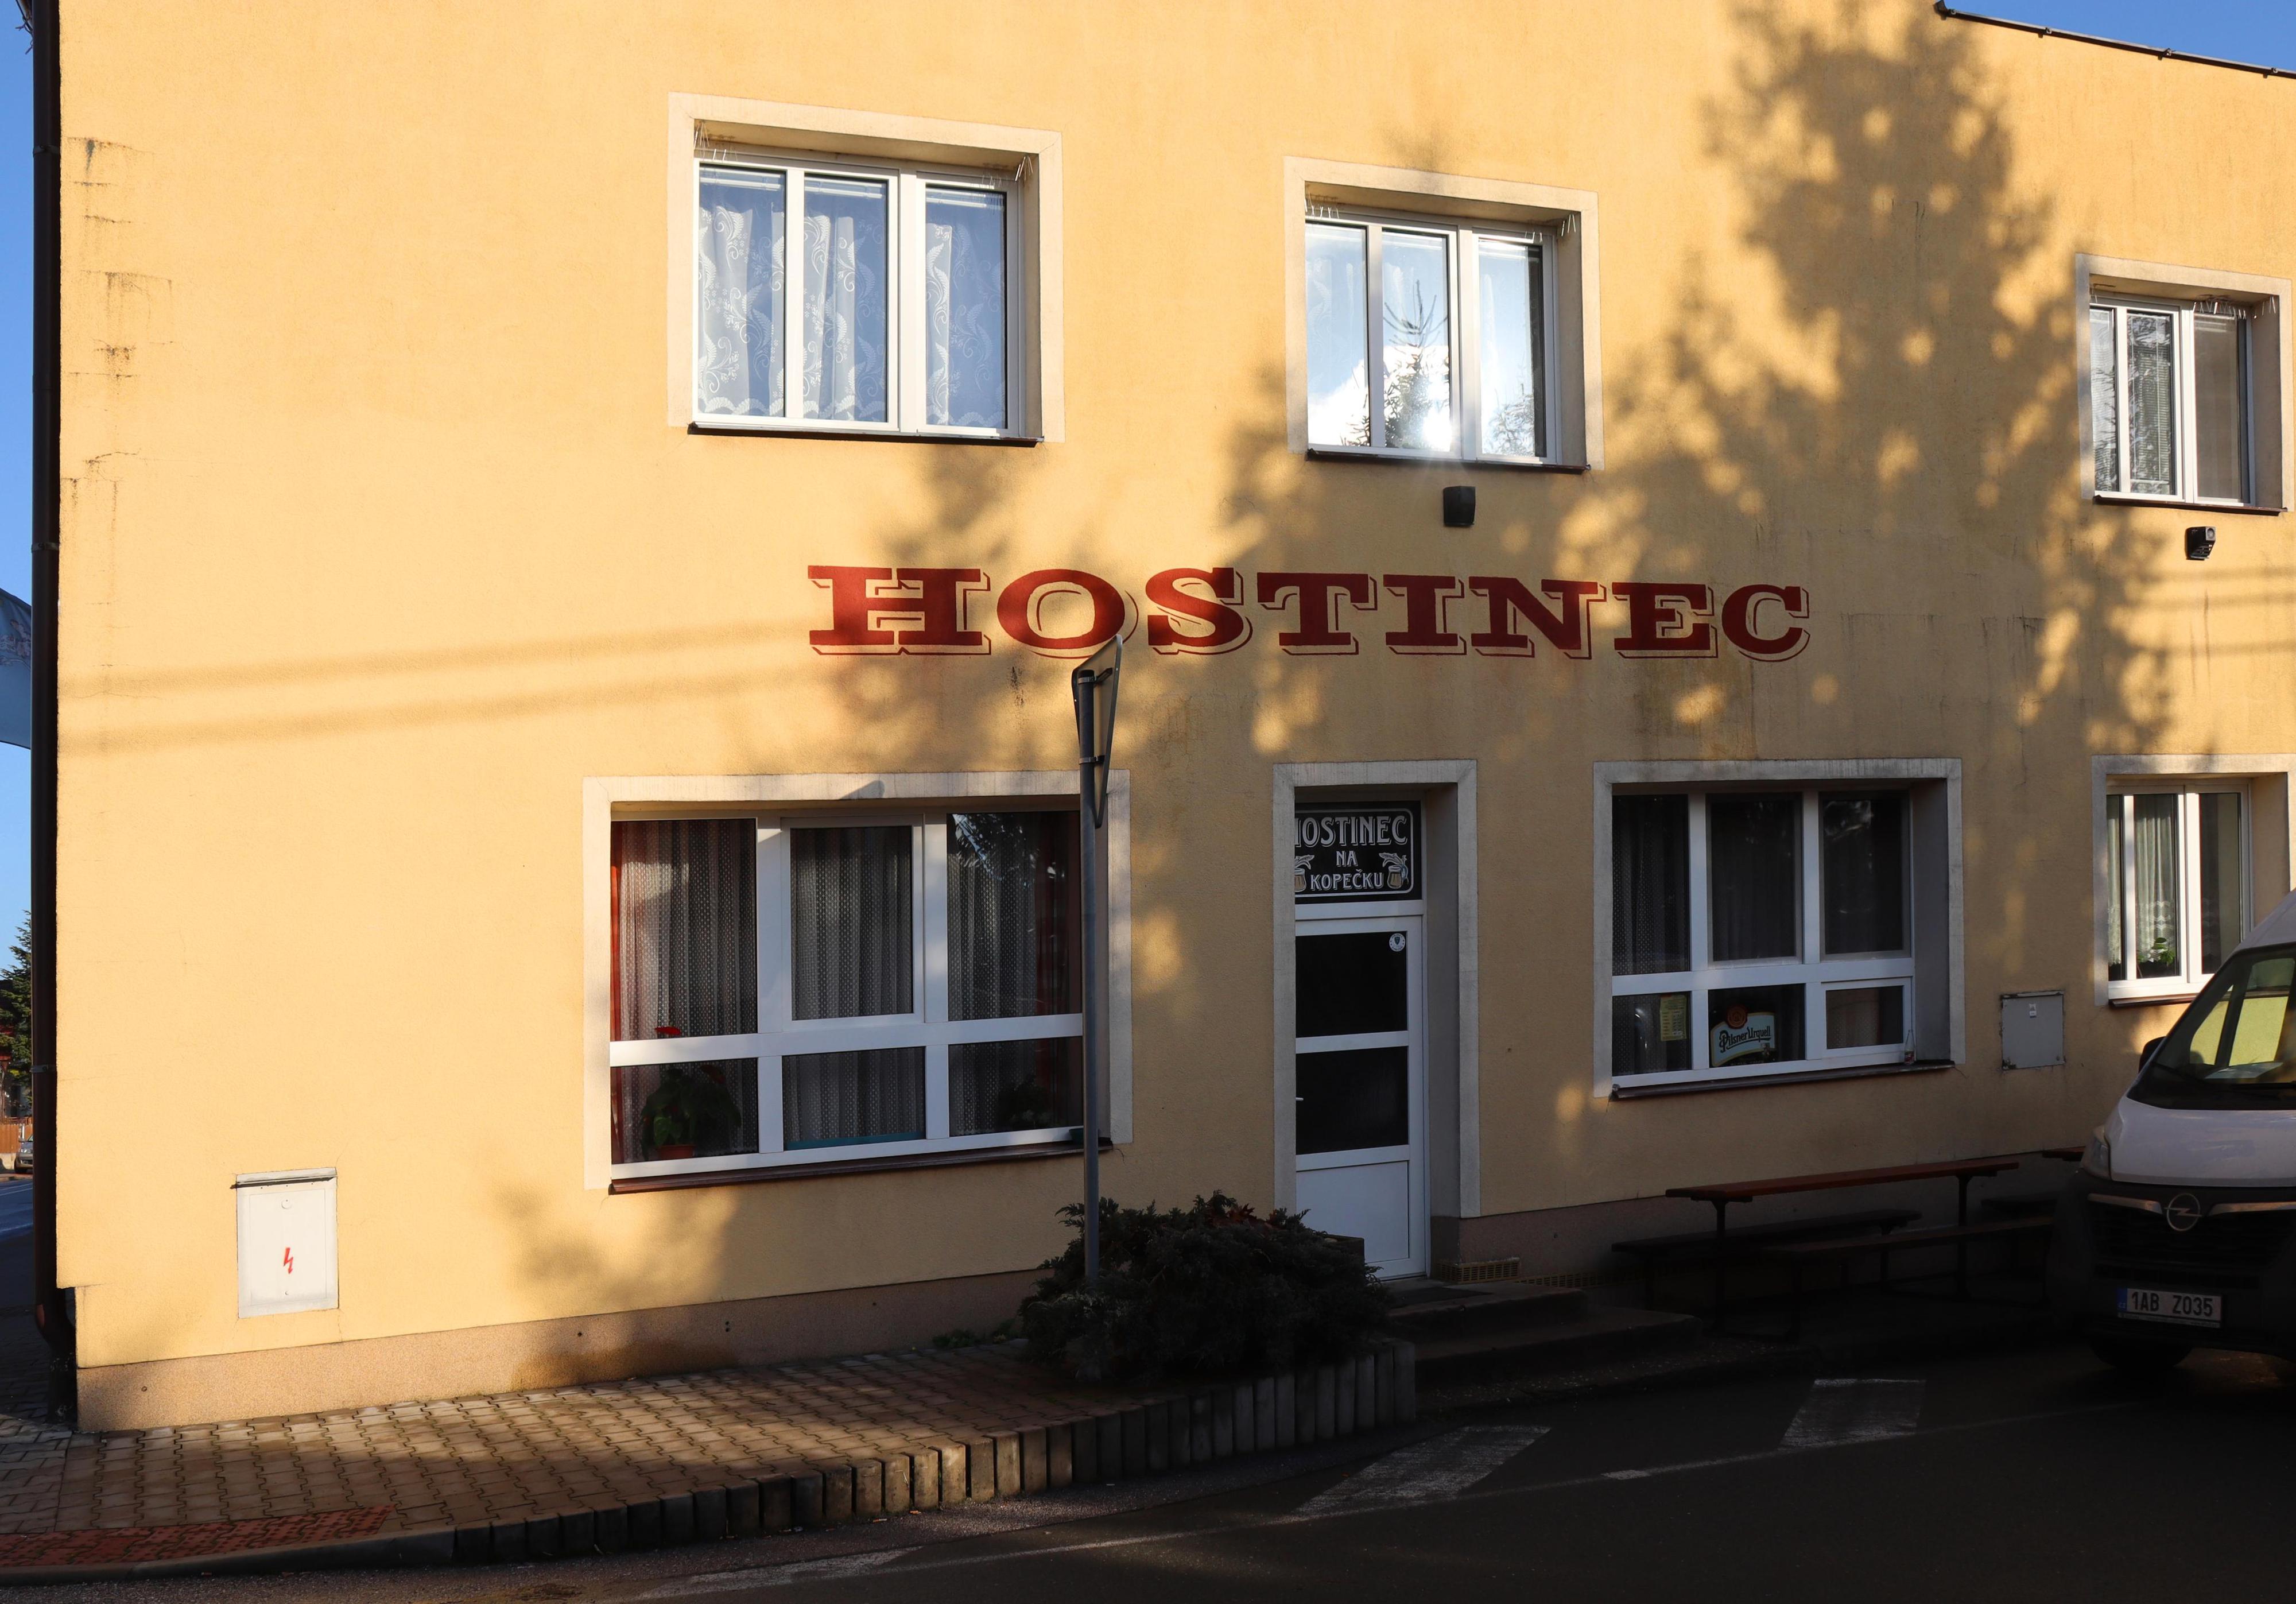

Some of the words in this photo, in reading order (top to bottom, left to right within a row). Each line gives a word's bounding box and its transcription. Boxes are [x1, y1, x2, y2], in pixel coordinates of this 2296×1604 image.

[808, 565, 1810, 662] HOSTINEC
[1336, 850, 1359, 867] NA
[1310, 869, 1384, 891] KOPEČKU
[1719, 1030, 1748, 1053] Pilsner
[1747, 1026, 1771, 1043] Urquell
[2131, 1291, 2159, 1312] 1AB
[2173, 1295, 2213, 1317] Z035
